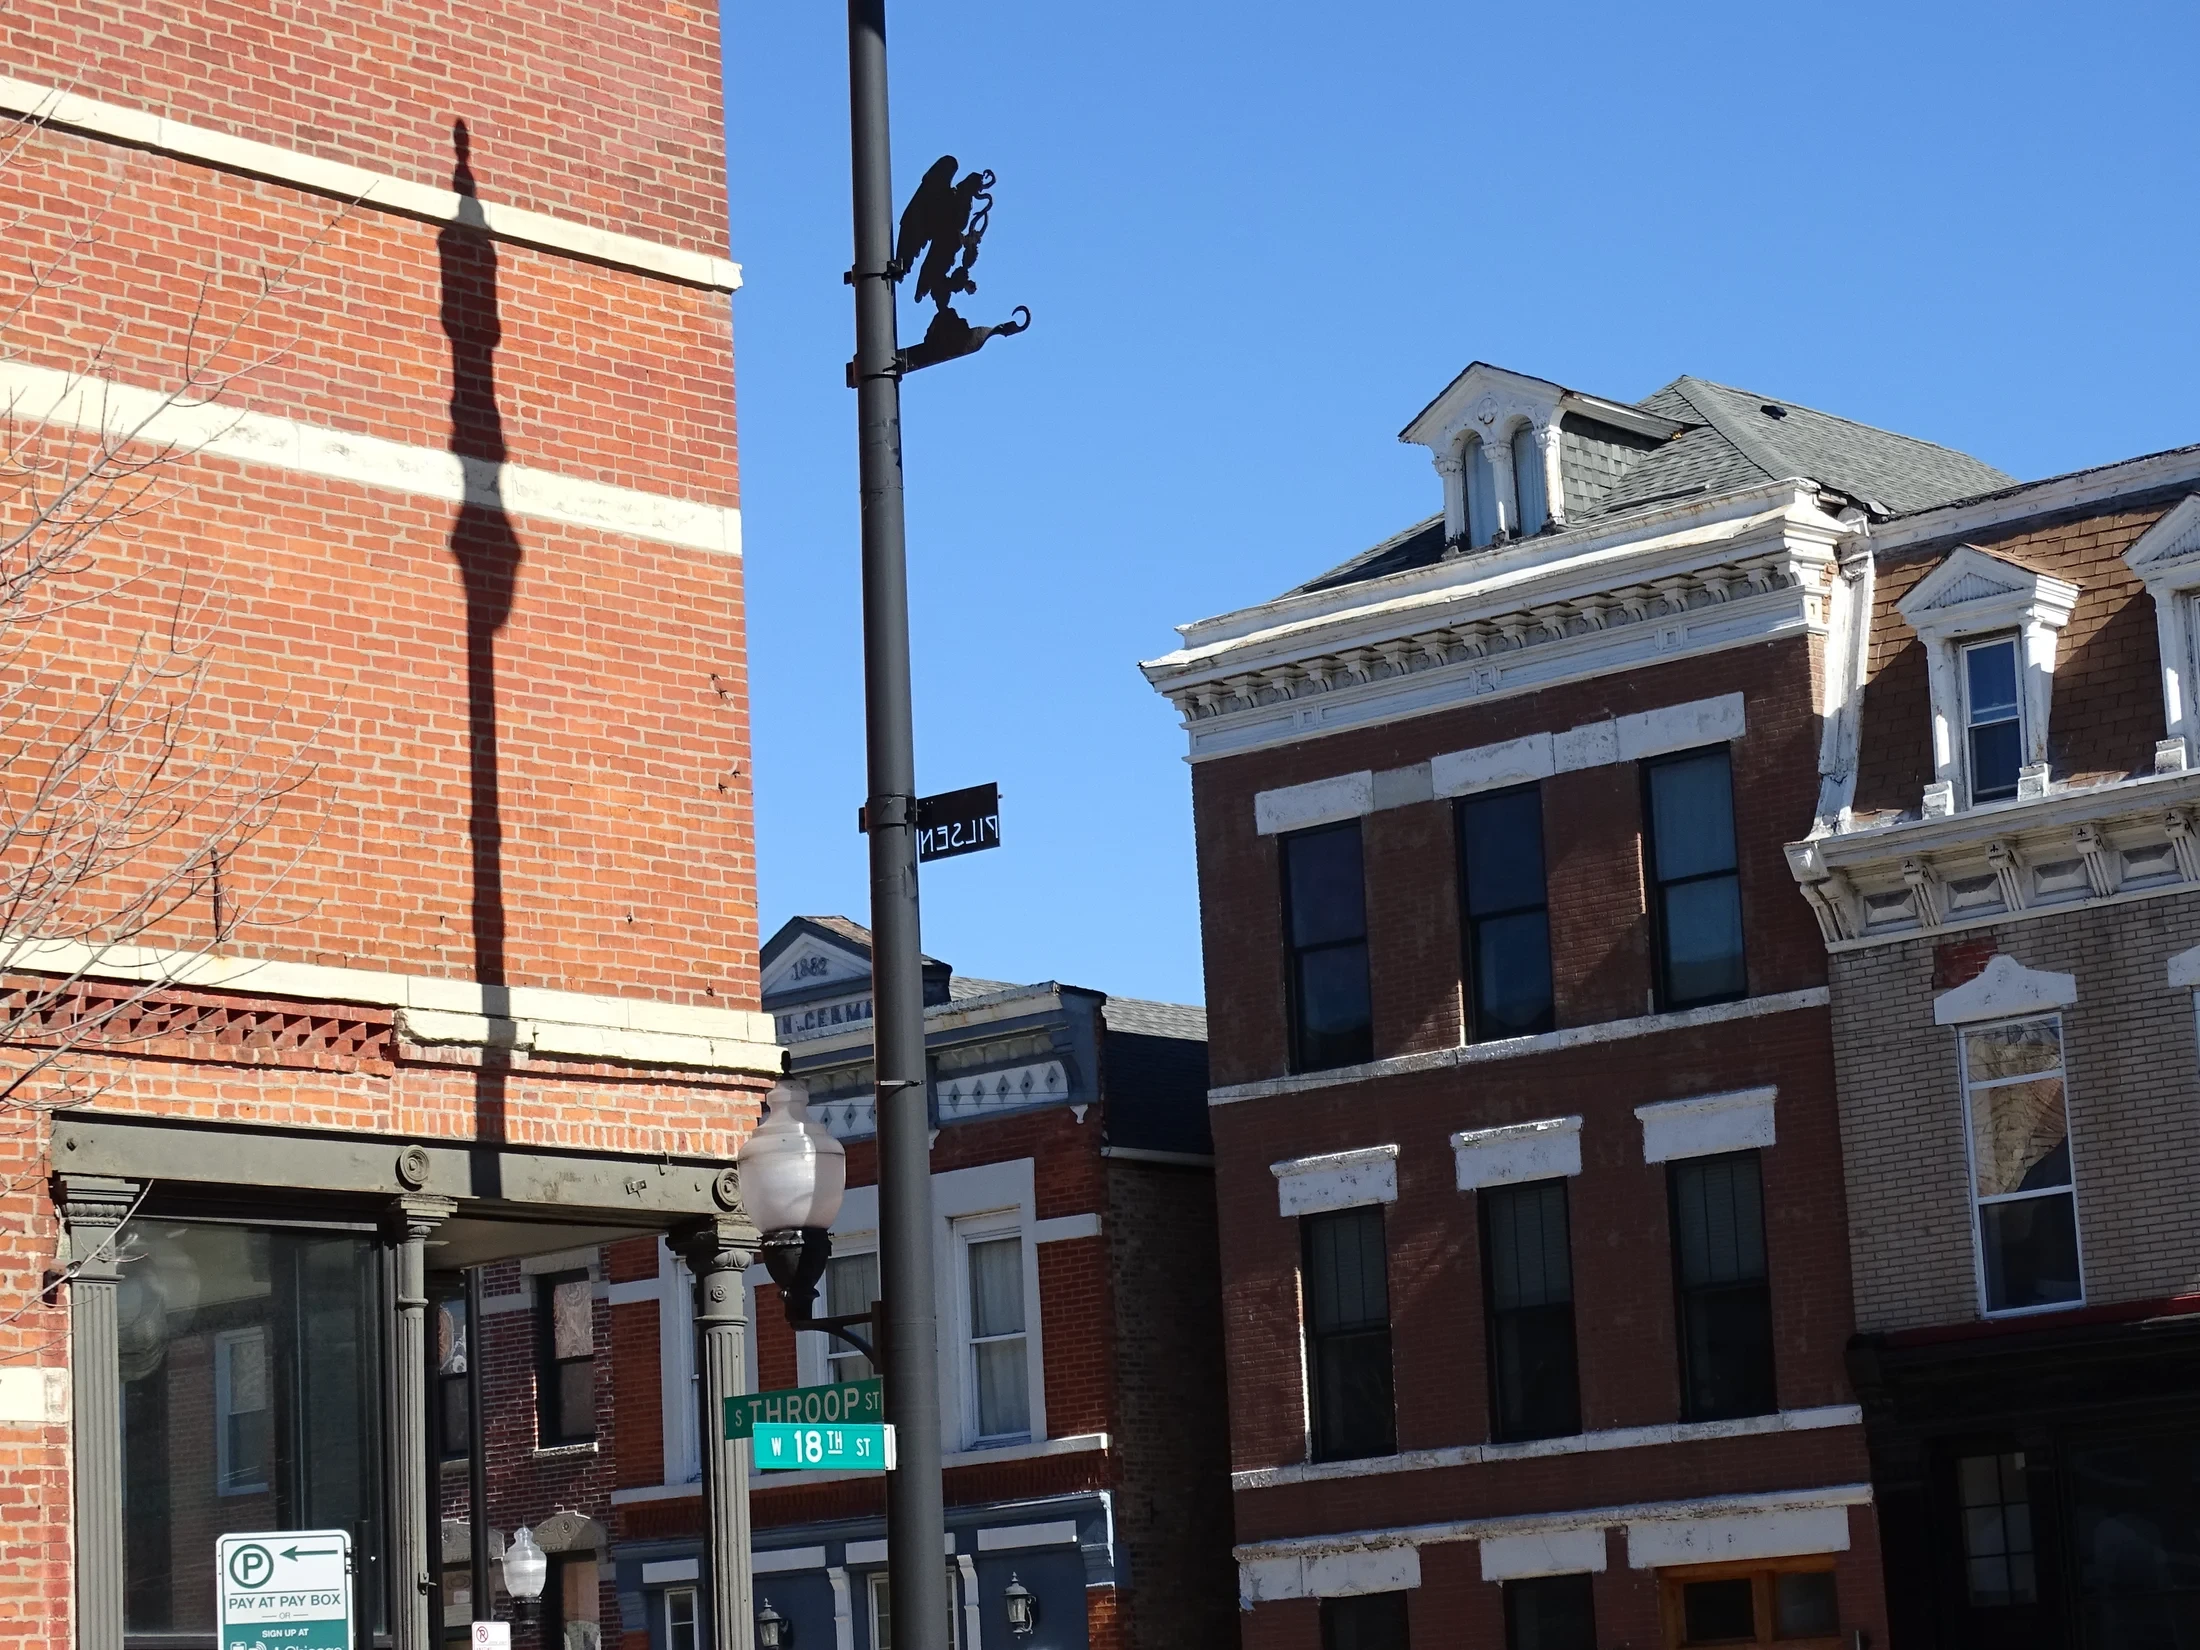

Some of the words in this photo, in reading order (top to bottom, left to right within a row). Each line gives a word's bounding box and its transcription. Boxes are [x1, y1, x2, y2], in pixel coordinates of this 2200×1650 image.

[735, 1409, 743, 1428] S
[748, 1388, 859, 1424] THROOP
[865, 1391, 880, 1411] ST
[771, 1437, 782, 1457] W
[793, 1430, 843, 1464] 18TH
[856, 1438, 871, 1457] ST
[229, 1597, 255, 1610] PAY
[259, 1596, 275, 1609] AT
[280, 1595, 306, 1608] PAY
[311, 1593, 341, 1606] BOX
[262, 1629, 283, 1638] SIGN
[284, 1628, 296, 1637] UP
[298, 1628, 309, 1636] AT
